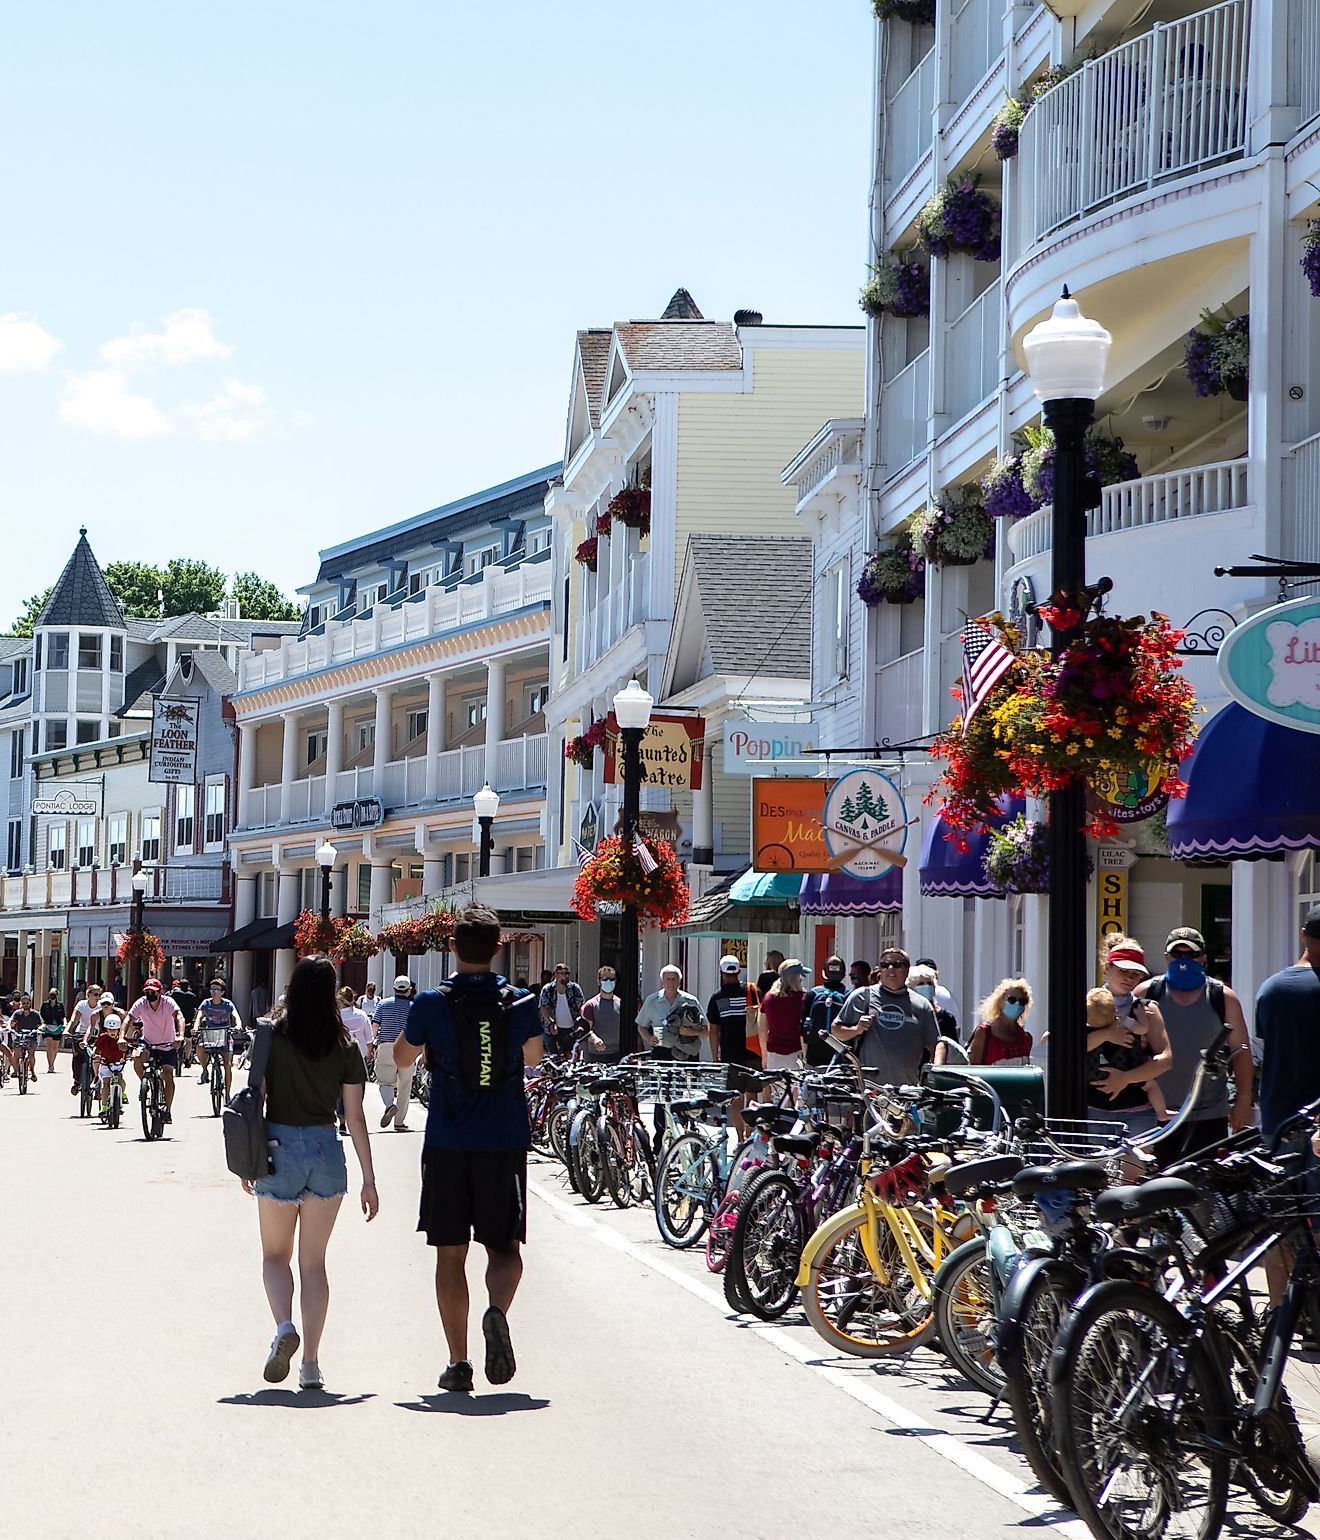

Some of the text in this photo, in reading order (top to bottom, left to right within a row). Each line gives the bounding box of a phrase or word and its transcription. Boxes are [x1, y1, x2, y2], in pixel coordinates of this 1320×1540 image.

[161, 729, 189, 740] LOON
[153, 738, 195, 750] FEATHER
[729, 731, 814, 761] Poppins
[617, 741, 688, 763] aunted
[35, 802, 66, 810] PONTIAC
[1140, 796, 1163, 814] toys
[835, 819, 896, 841] CANVAS & PADDLE
[1103, 858, 1124, 866] TREE
[881, 1011, 904, 1021] PEPSI
[479, 1021, 492, 1087] NATHAN
